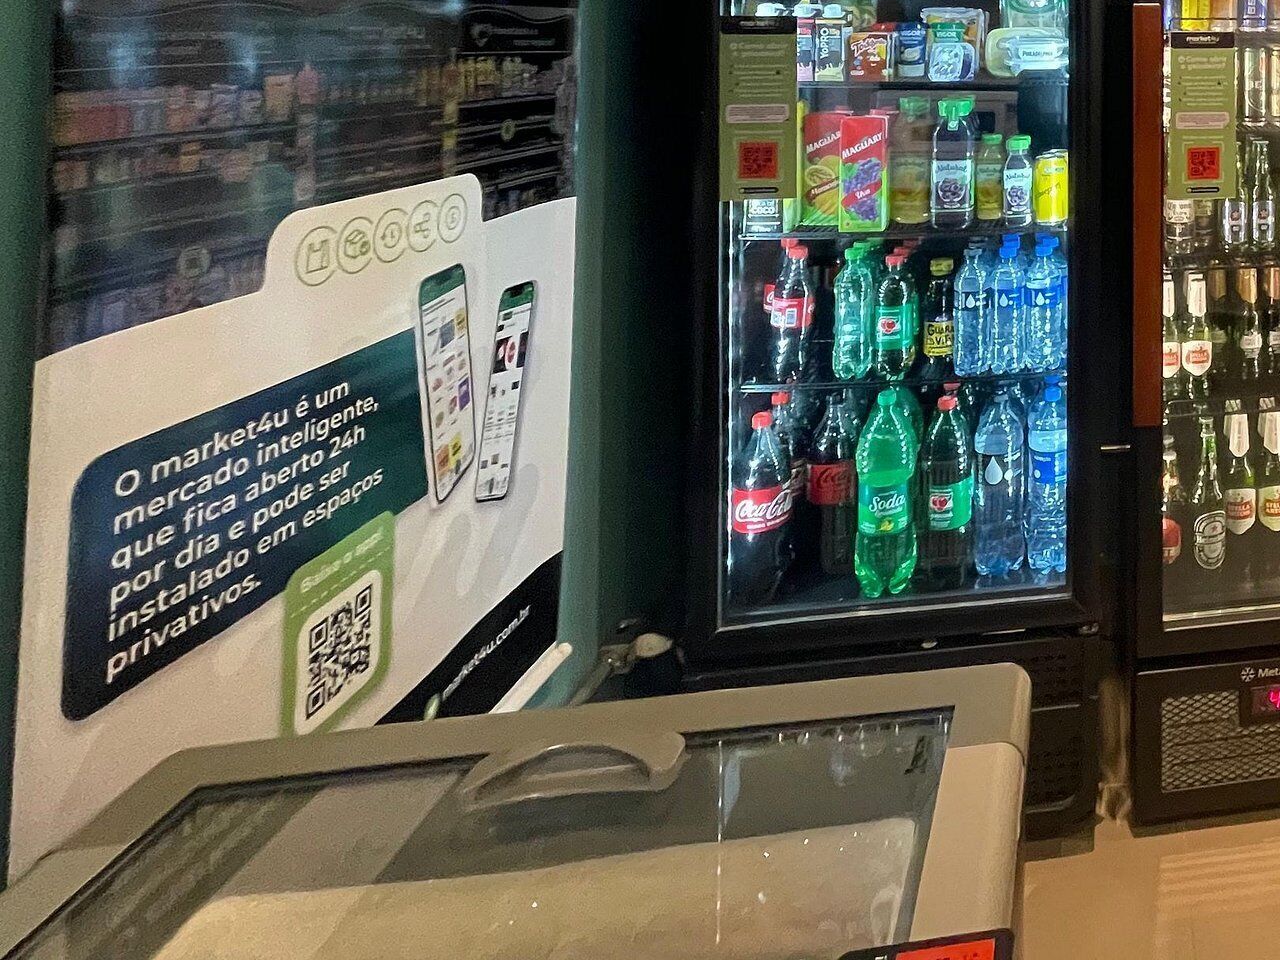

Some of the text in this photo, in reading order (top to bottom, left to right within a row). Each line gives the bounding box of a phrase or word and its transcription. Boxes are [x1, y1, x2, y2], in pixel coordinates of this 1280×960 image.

[819, 27, 830, 59] YoPRO
[841, 131, 883, 160] MAGUARY
[110, 424, 366, 571] que fica aberto 24h
[113, 394, 379, 536] mercado inteligente,
[114, 381, 349, 498] O market4u é um
[107, 465, 384, 642] instalado em espaços
[110, 459, 352, 612] por dia e pode ser
[869, 491, 906, 513] Soda
[105, 571, 262, 685] privativos.
